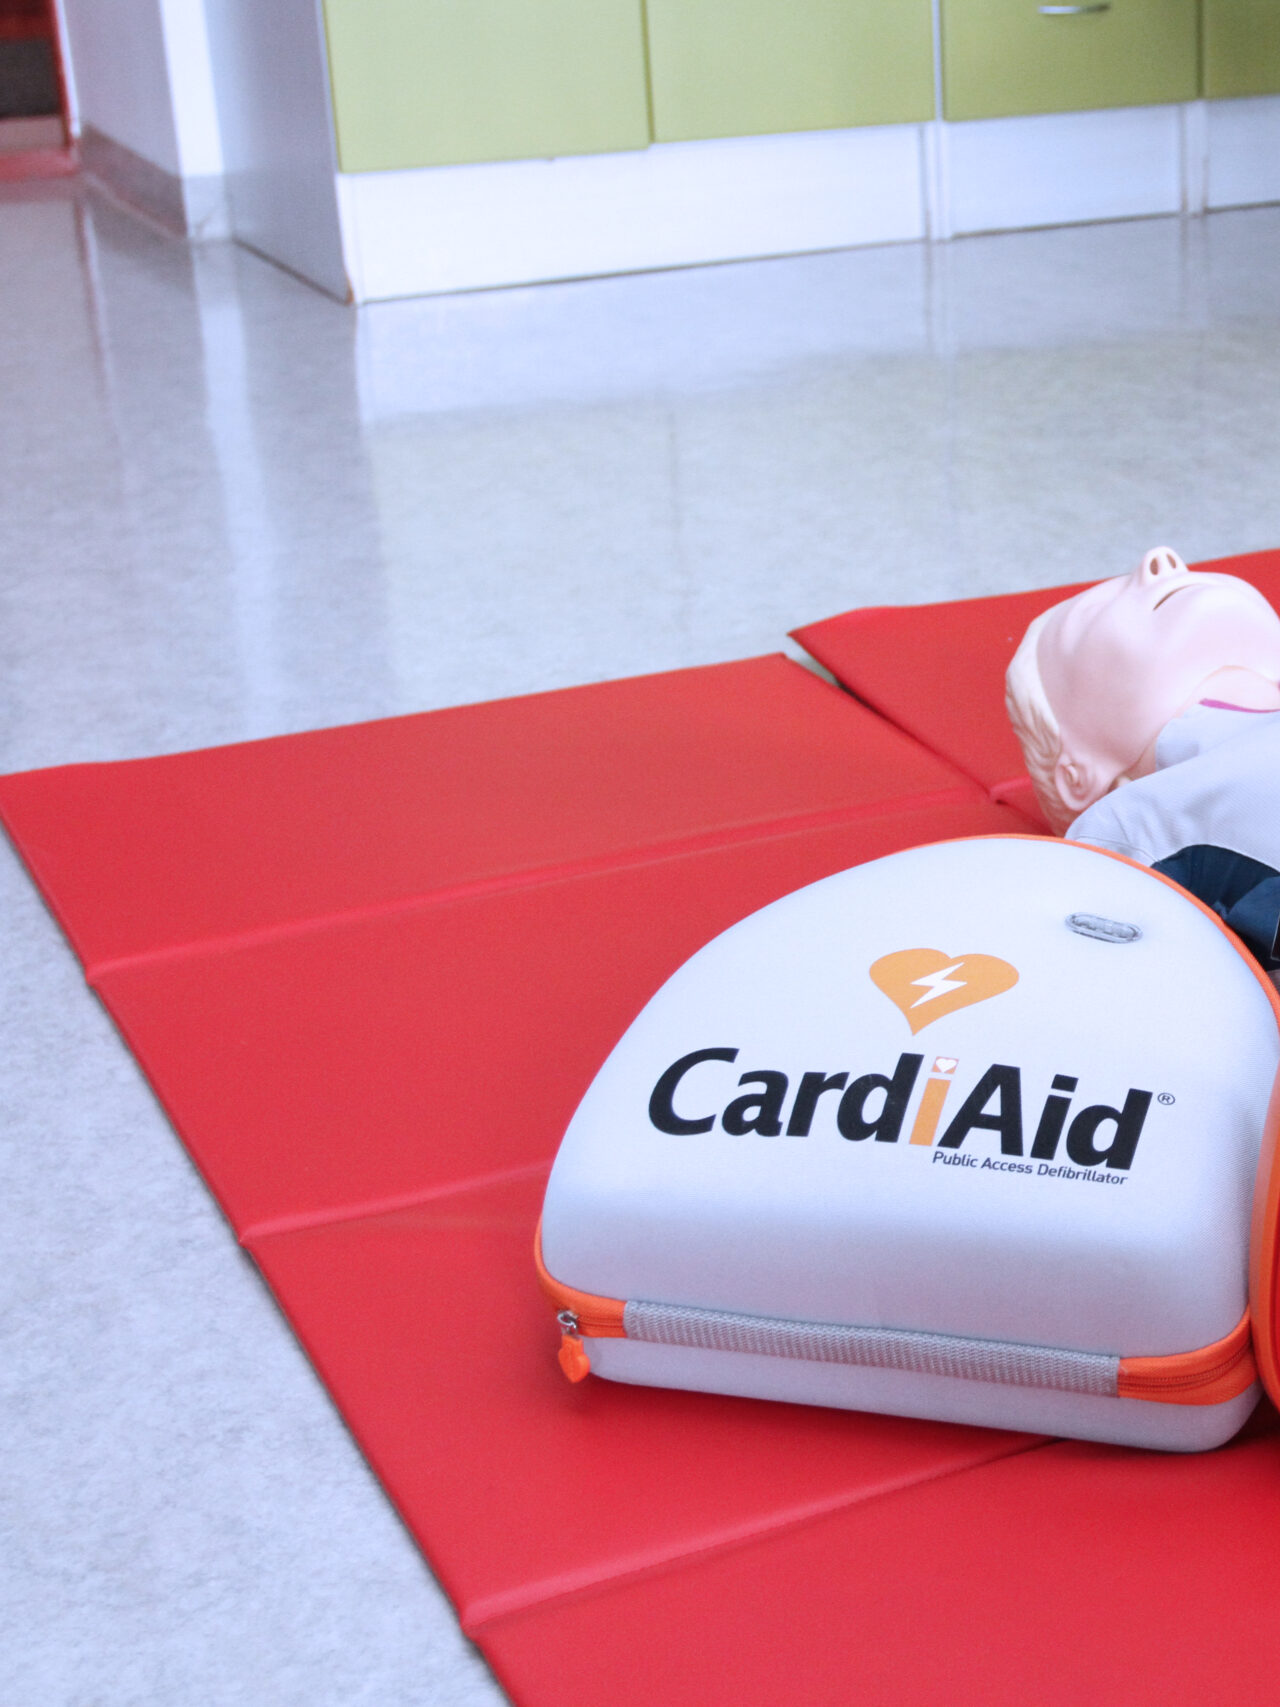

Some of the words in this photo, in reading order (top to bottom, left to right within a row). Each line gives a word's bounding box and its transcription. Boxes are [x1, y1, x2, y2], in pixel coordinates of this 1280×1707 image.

[932, 1151, 978, 1168] Public
[980, 1156, 1033, 1174] Access
[1037, 1163, 1128, 1185] Defibrillator
